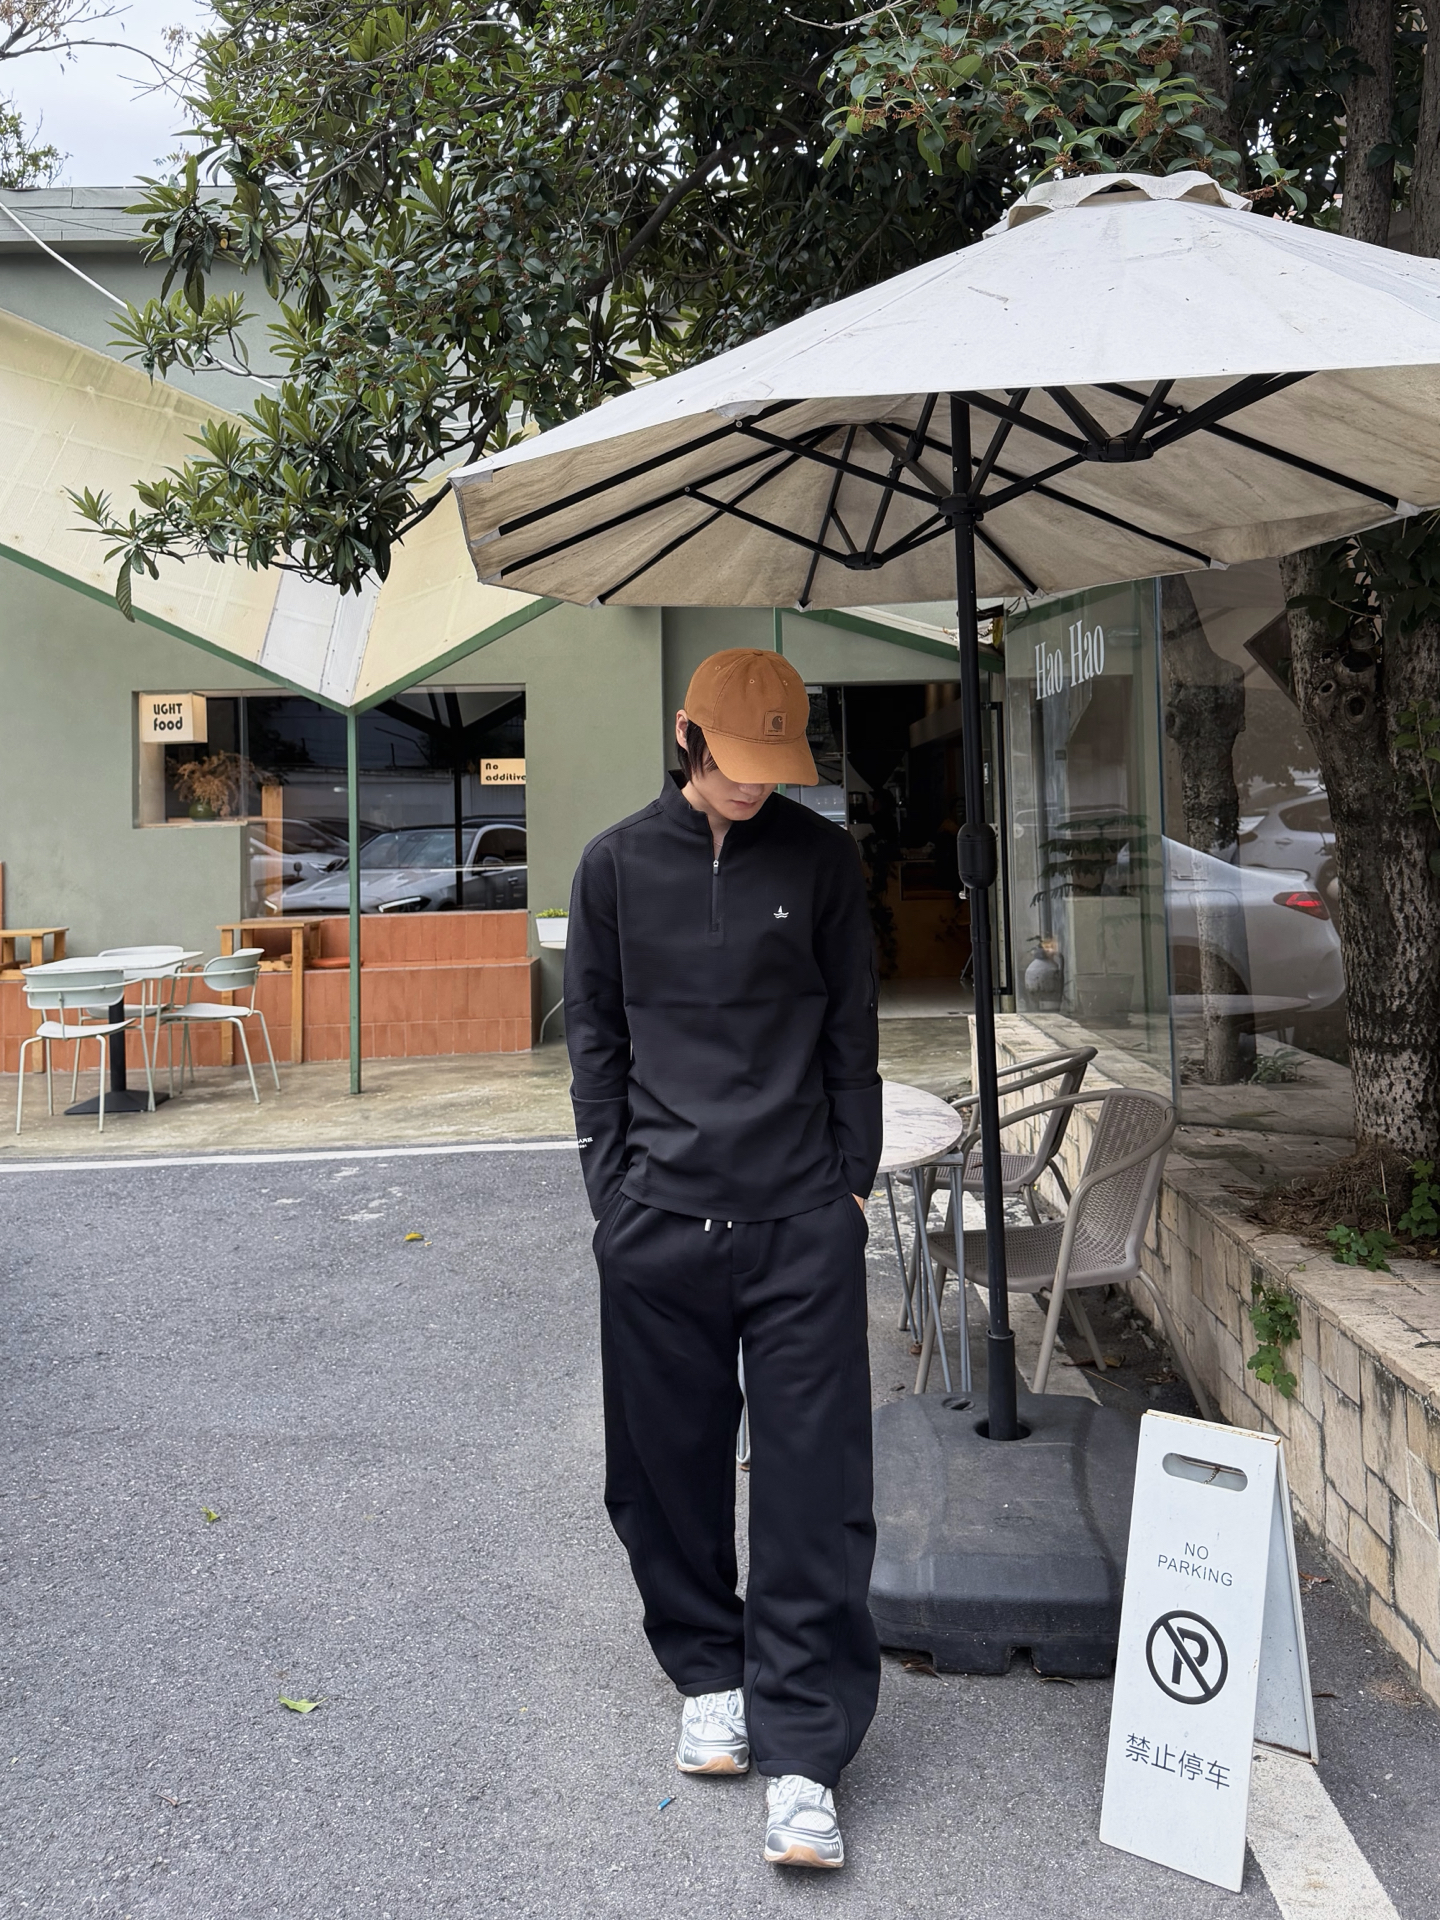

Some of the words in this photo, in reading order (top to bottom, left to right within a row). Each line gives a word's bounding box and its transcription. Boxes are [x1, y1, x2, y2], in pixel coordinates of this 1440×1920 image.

[1034, 641, 1063, 701] Hao
[1069, 620, 1105, 688] Hao
[153, 716, 183, 731] food
[1184, 1541, 1209, 1560] NO
[1157, 1554, 1233, 1587] PARKING
[1125, 1732, 1231, 1791] 禁止停车
